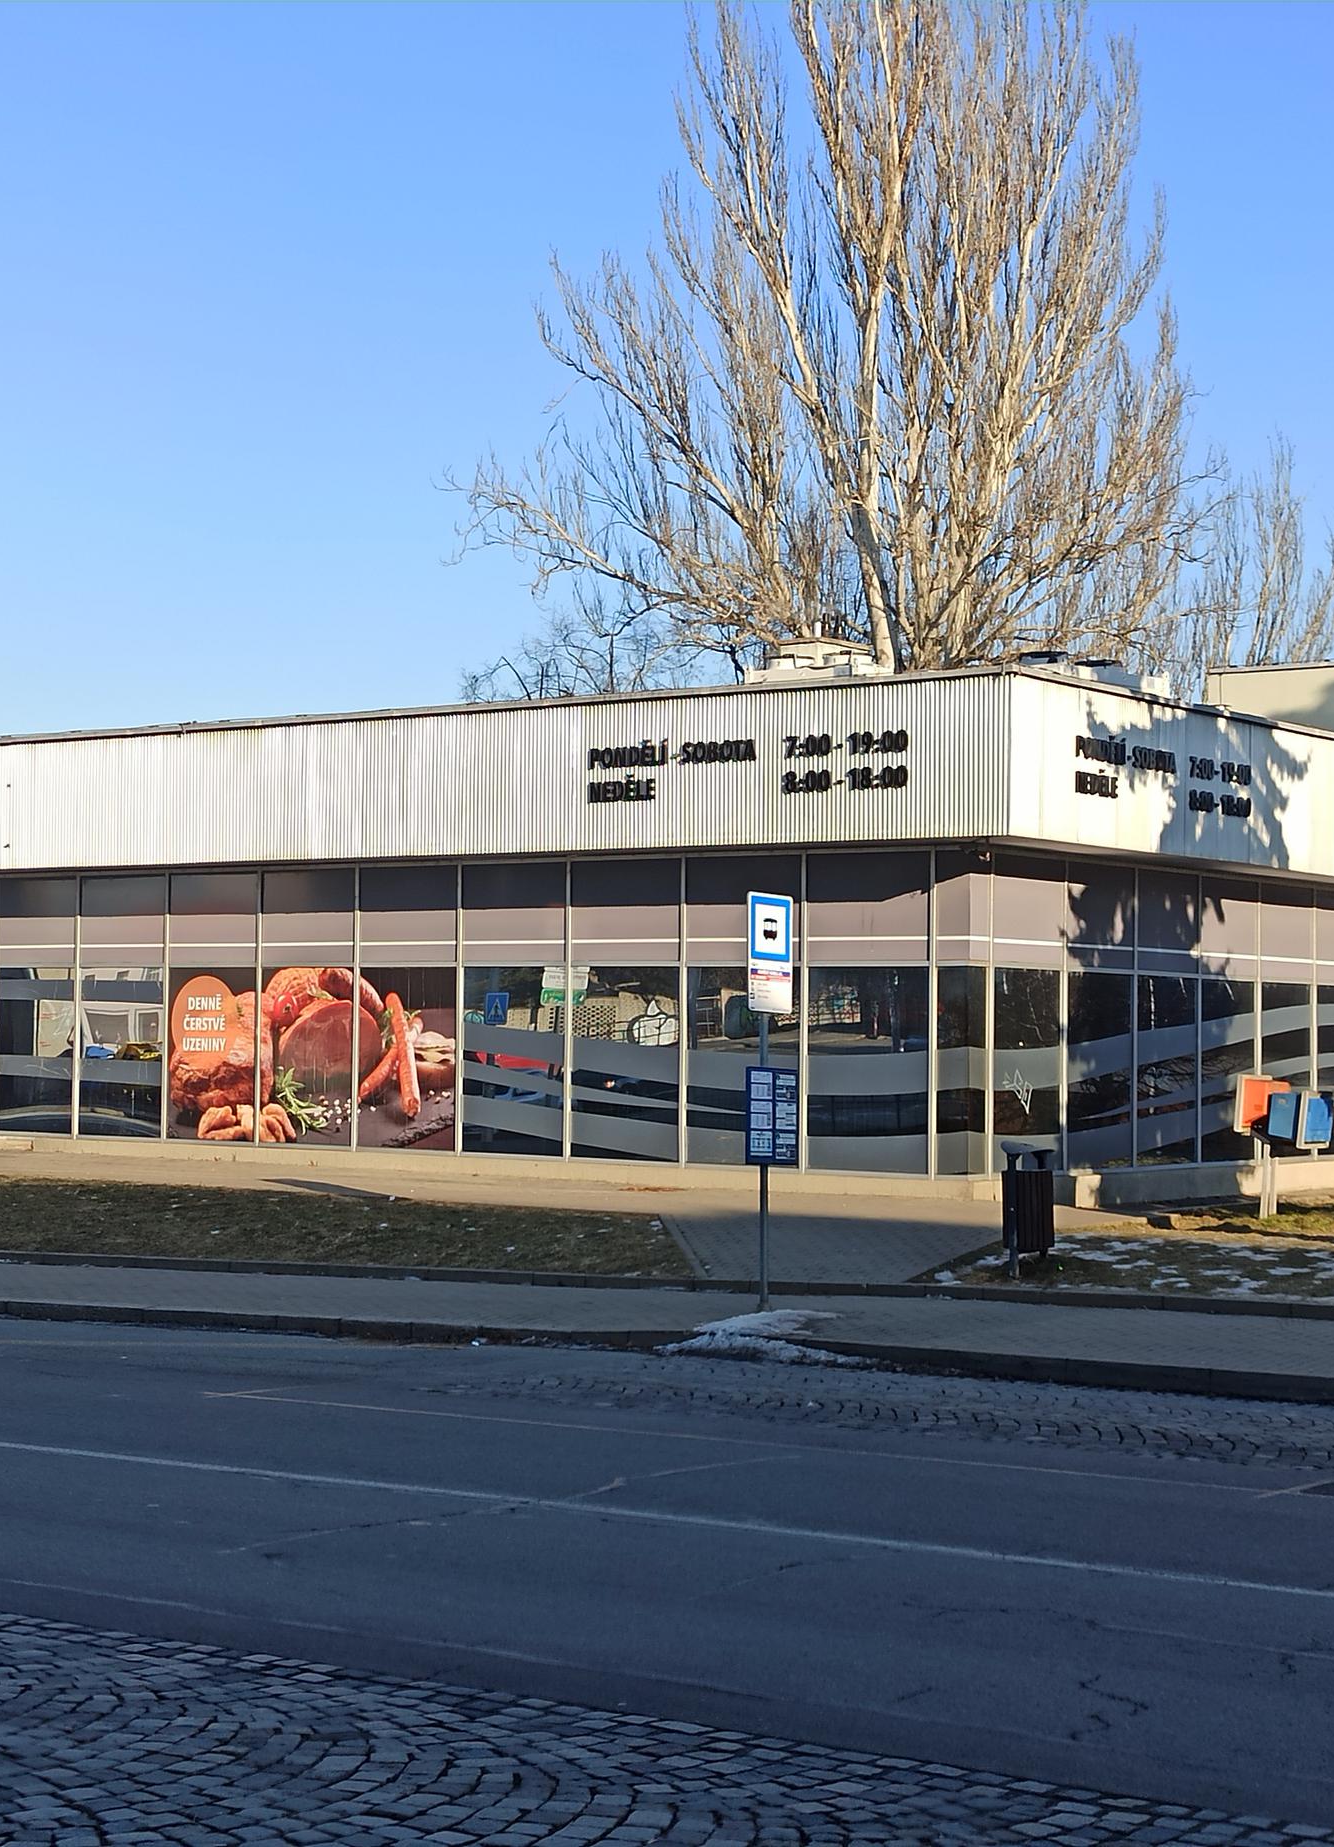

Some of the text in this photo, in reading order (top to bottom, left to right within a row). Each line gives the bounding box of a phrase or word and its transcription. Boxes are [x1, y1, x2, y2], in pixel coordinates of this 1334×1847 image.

[679, 738, 757, 765] SOBOTA
[587, 773, 657, 804] NEDĚLE
[188, 994, 222, 1011] DENNĚ
[183, 1014, 226, 1031] ČERSTVÉ
[182, 1037, 226, 1052] UZENINY
